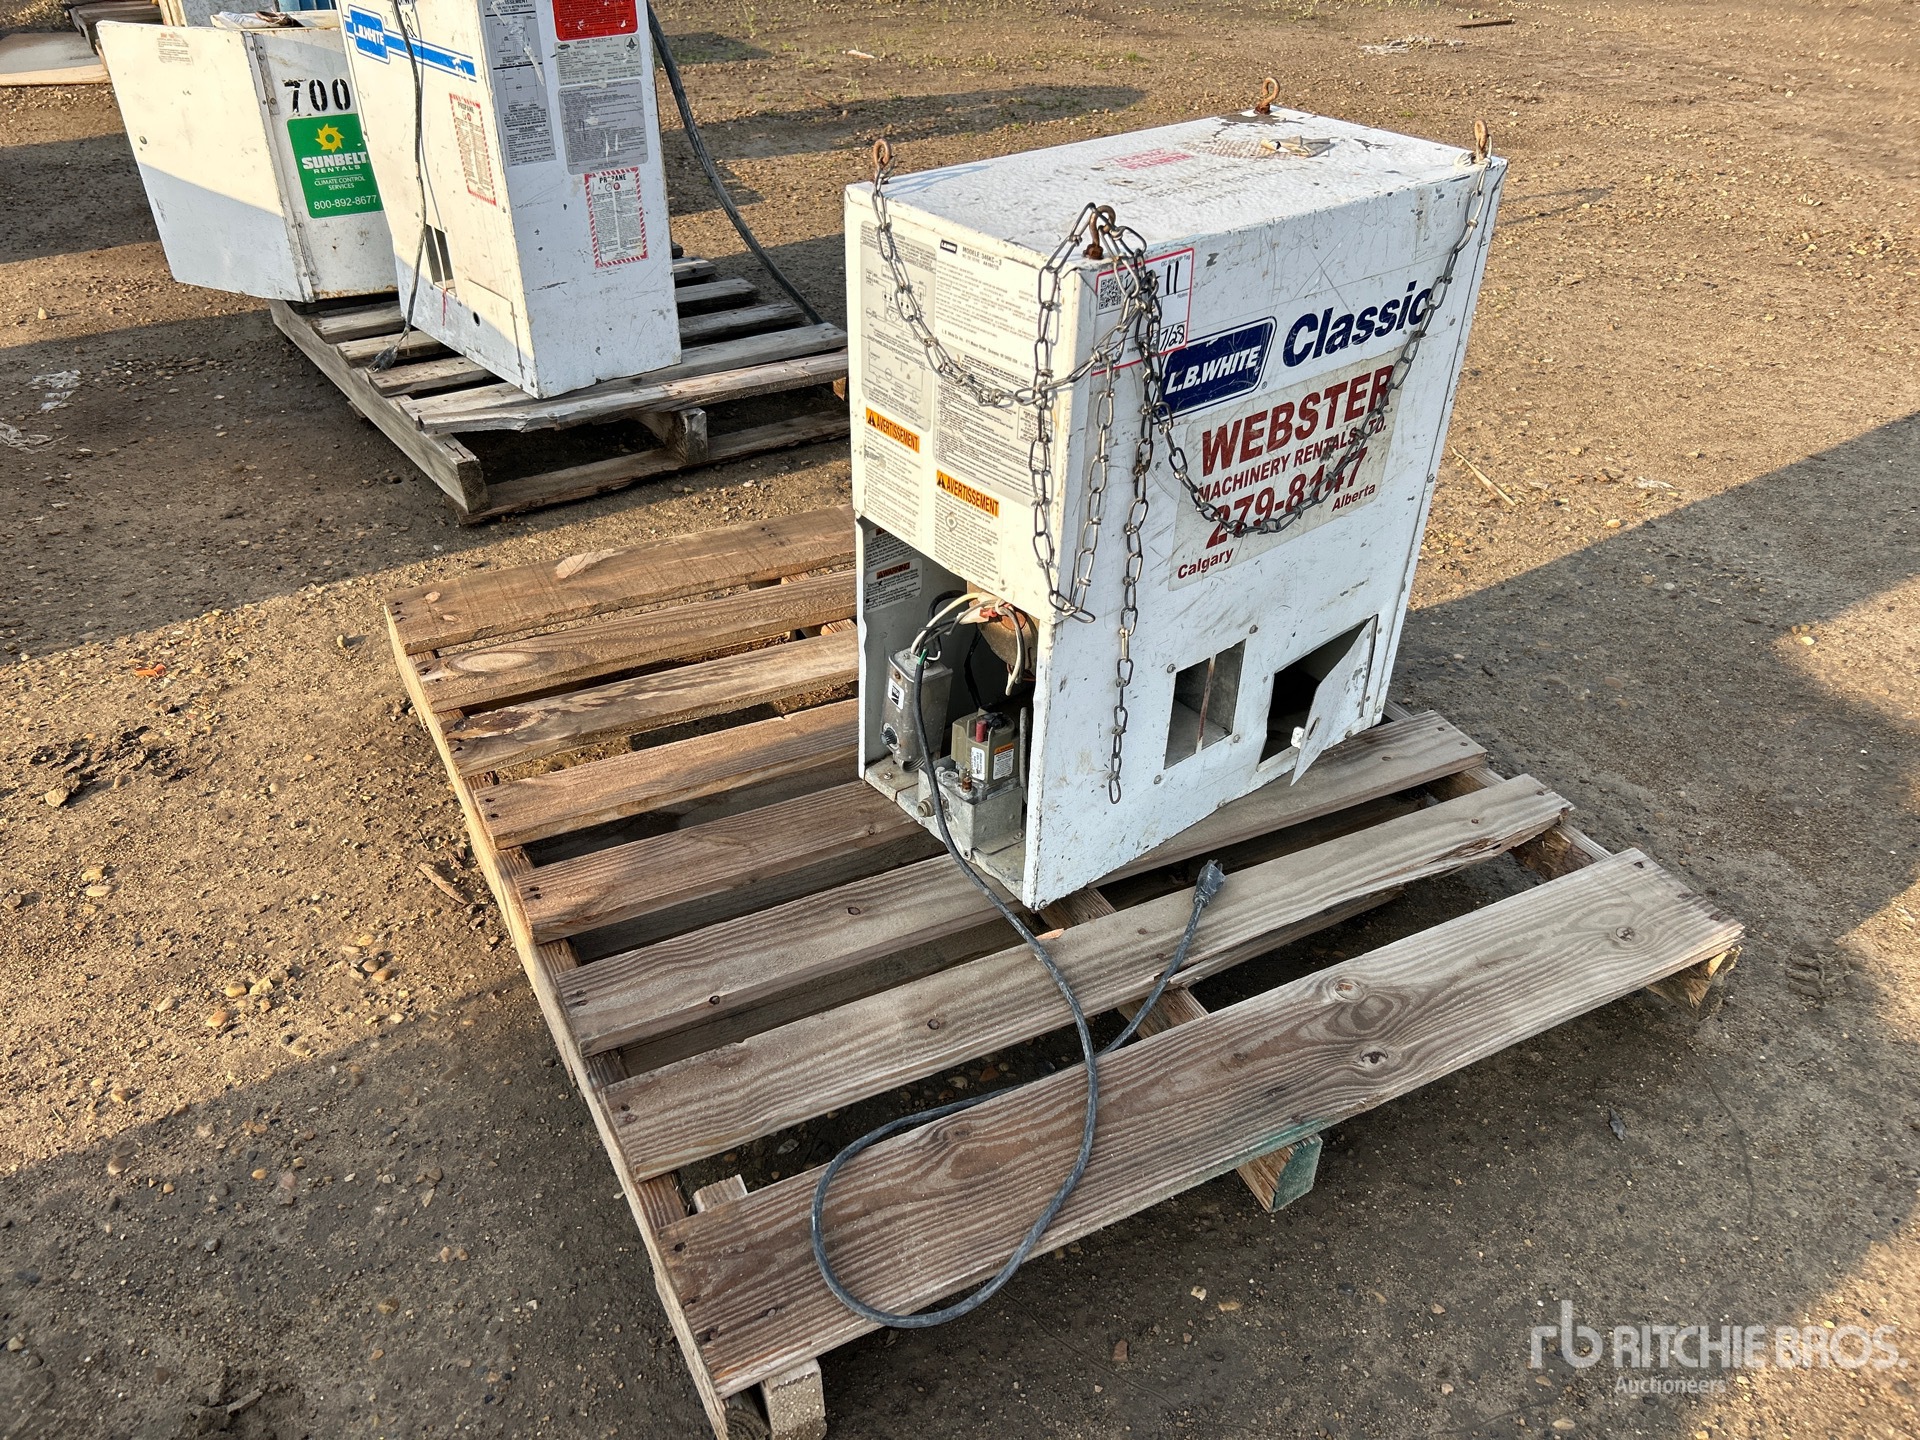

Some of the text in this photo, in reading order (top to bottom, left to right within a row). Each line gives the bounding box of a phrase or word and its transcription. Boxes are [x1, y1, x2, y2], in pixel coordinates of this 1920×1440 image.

[283, 78, 351, 114] 700
[301, 151, 367, 170] SUNBELT
[313, 164, 361, 174] RENTALS
[314, 175, 366, 187] CLIMATE CONTROL
[328, 182, 355, 191] SERVICES
[313, 194, 377, 210] 800-892-8677
[1283, 280, 1434, 368] Classic
[1165, 344, 1262, 397] L.B.WHITE
[876, 413, 919, 453] AVERTISSEMENT
[1202, 364, 1394, 478] WEBSTER
[1199, 453, 1291, 502] MACHINERY
[1293, 427, 1359, 469] RENTALS
[946, 478, 999, 518] AVERTISSEMENT
[1331, 483, 1376, 513] Alberta
[1177, 548, 1234, 580] Calgary
